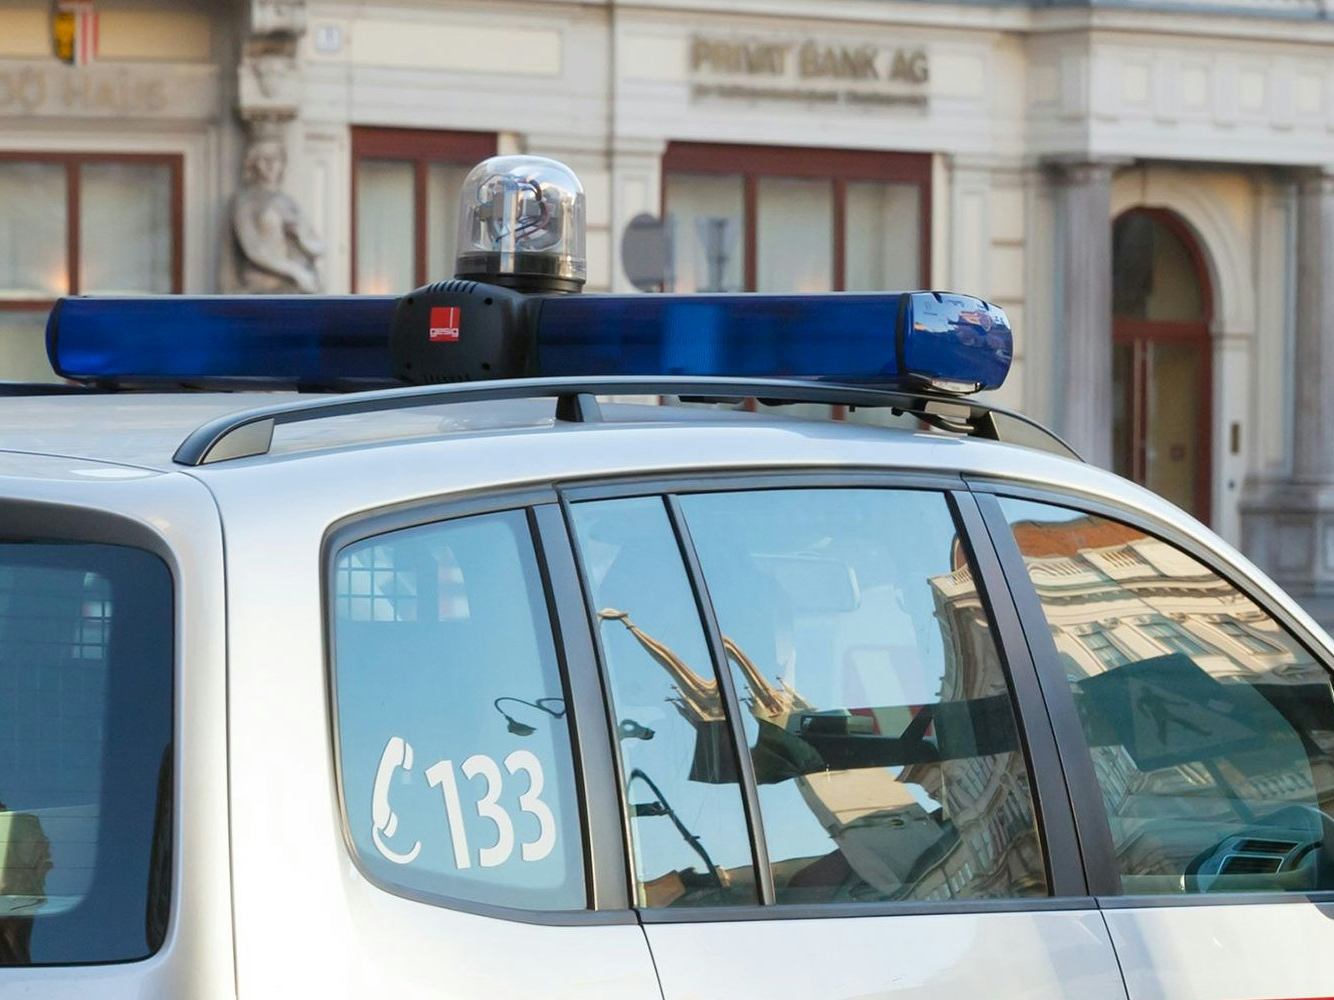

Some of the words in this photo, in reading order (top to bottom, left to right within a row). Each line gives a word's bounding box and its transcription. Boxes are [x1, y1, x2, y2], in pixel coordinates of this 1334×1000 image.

[690, 34, 794, 77] PRIVAT
[798, 39, 879, 81] BANK
[888, 47, 930, 85] AG
[424, 749, 556, 870] 133
